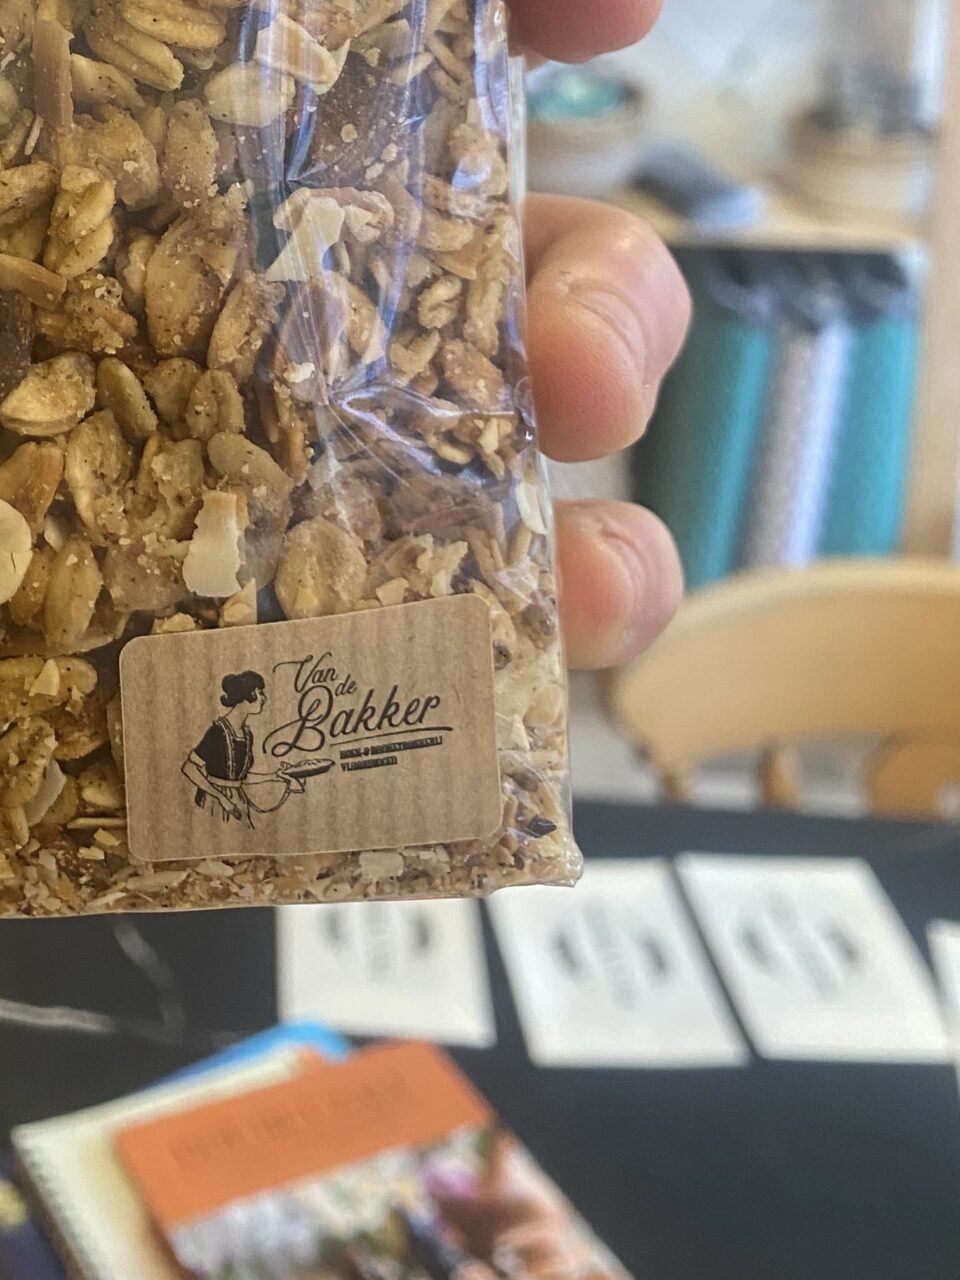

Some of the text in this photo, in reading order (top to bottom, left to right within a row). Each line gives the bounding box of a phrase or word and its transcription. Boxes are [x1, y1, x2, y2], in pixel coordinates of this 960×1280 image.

[272, 651, 358, 697] Van de
[263, 684, 442, 757] Bakker
